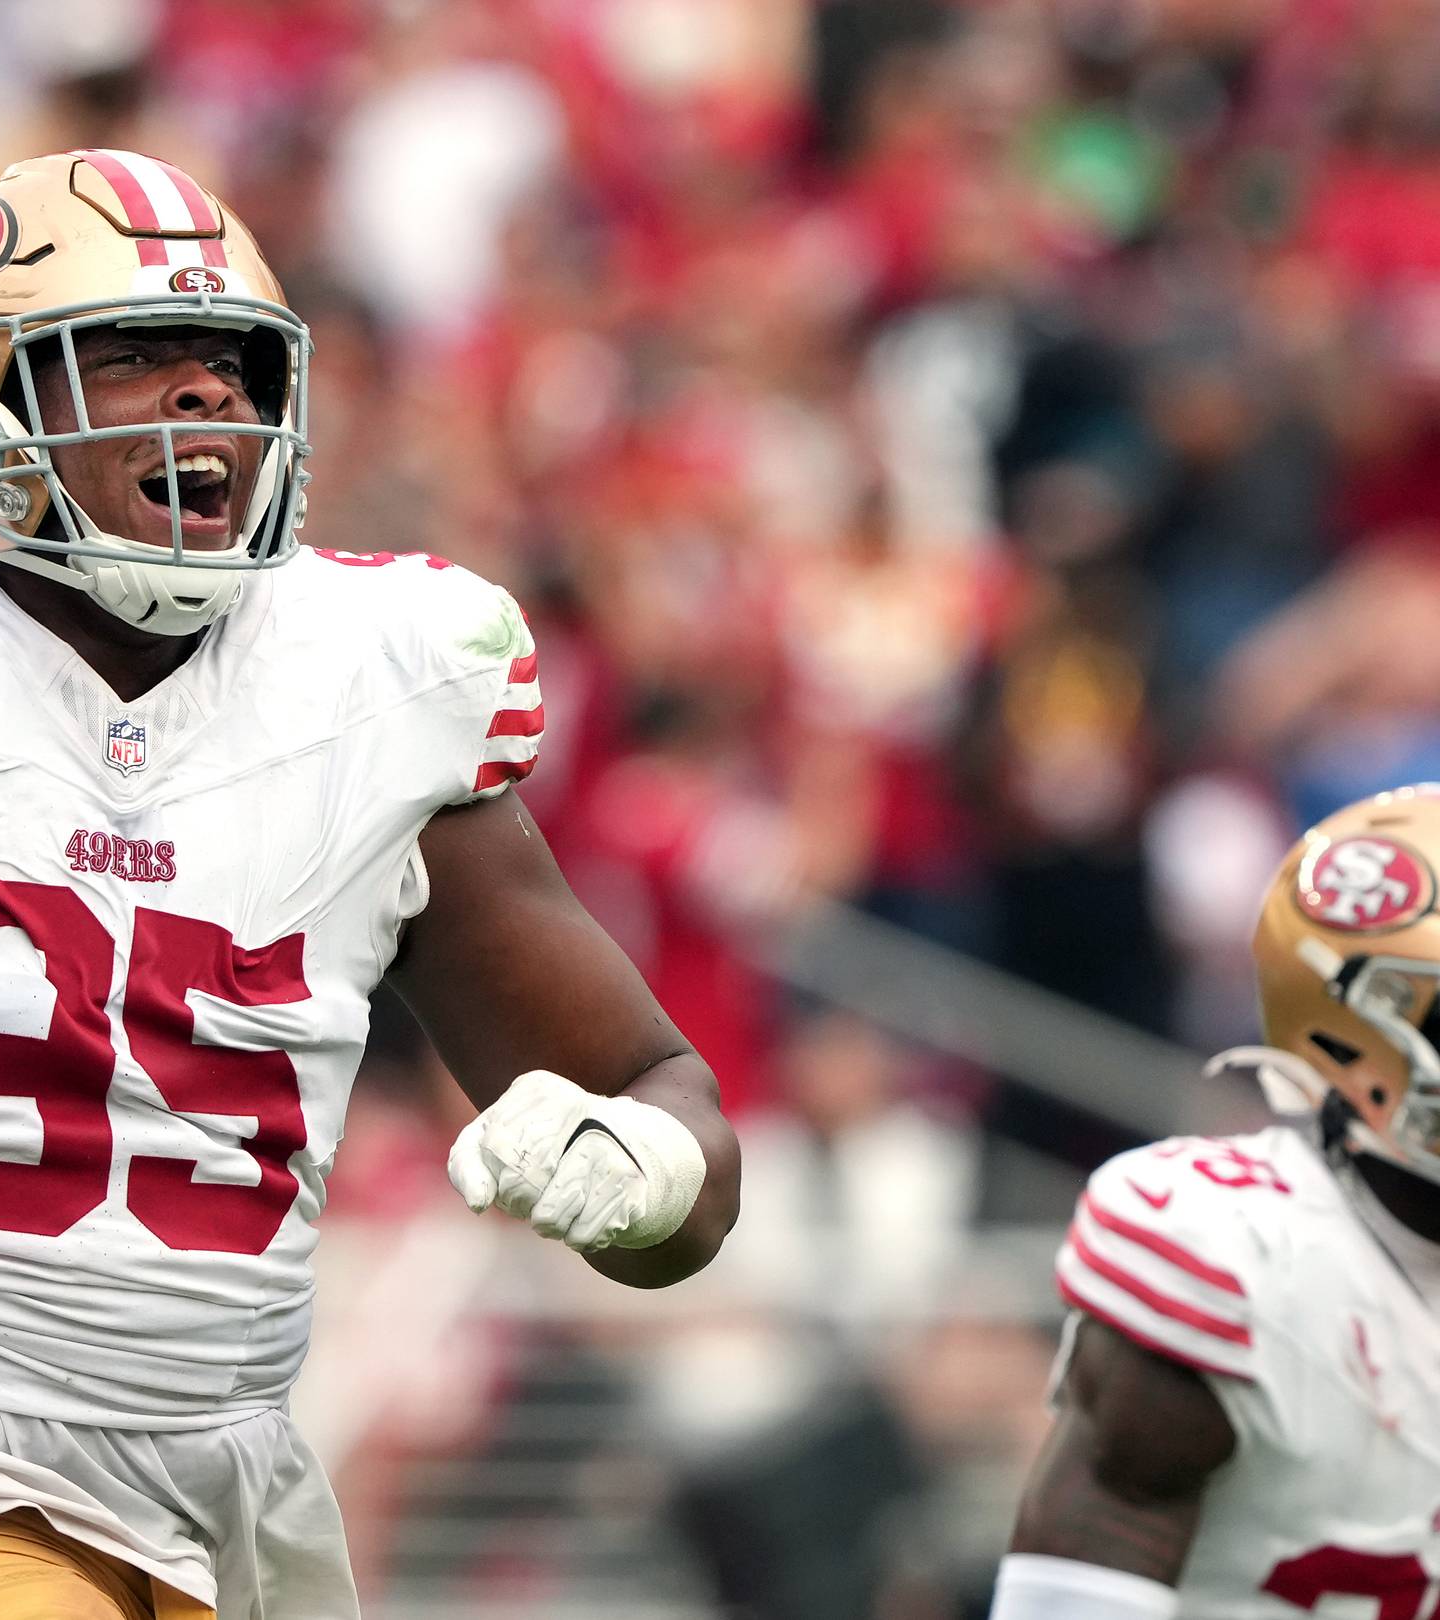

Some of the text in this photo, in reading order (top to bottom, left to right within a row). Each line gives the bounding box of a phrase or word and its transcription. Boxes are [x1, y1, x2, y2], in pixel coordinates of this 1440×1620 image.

[111, 739, 143, 764] NFL
[65, 829, 177, 882] 49ERS
[1321, 841, 1409, 924] SF
